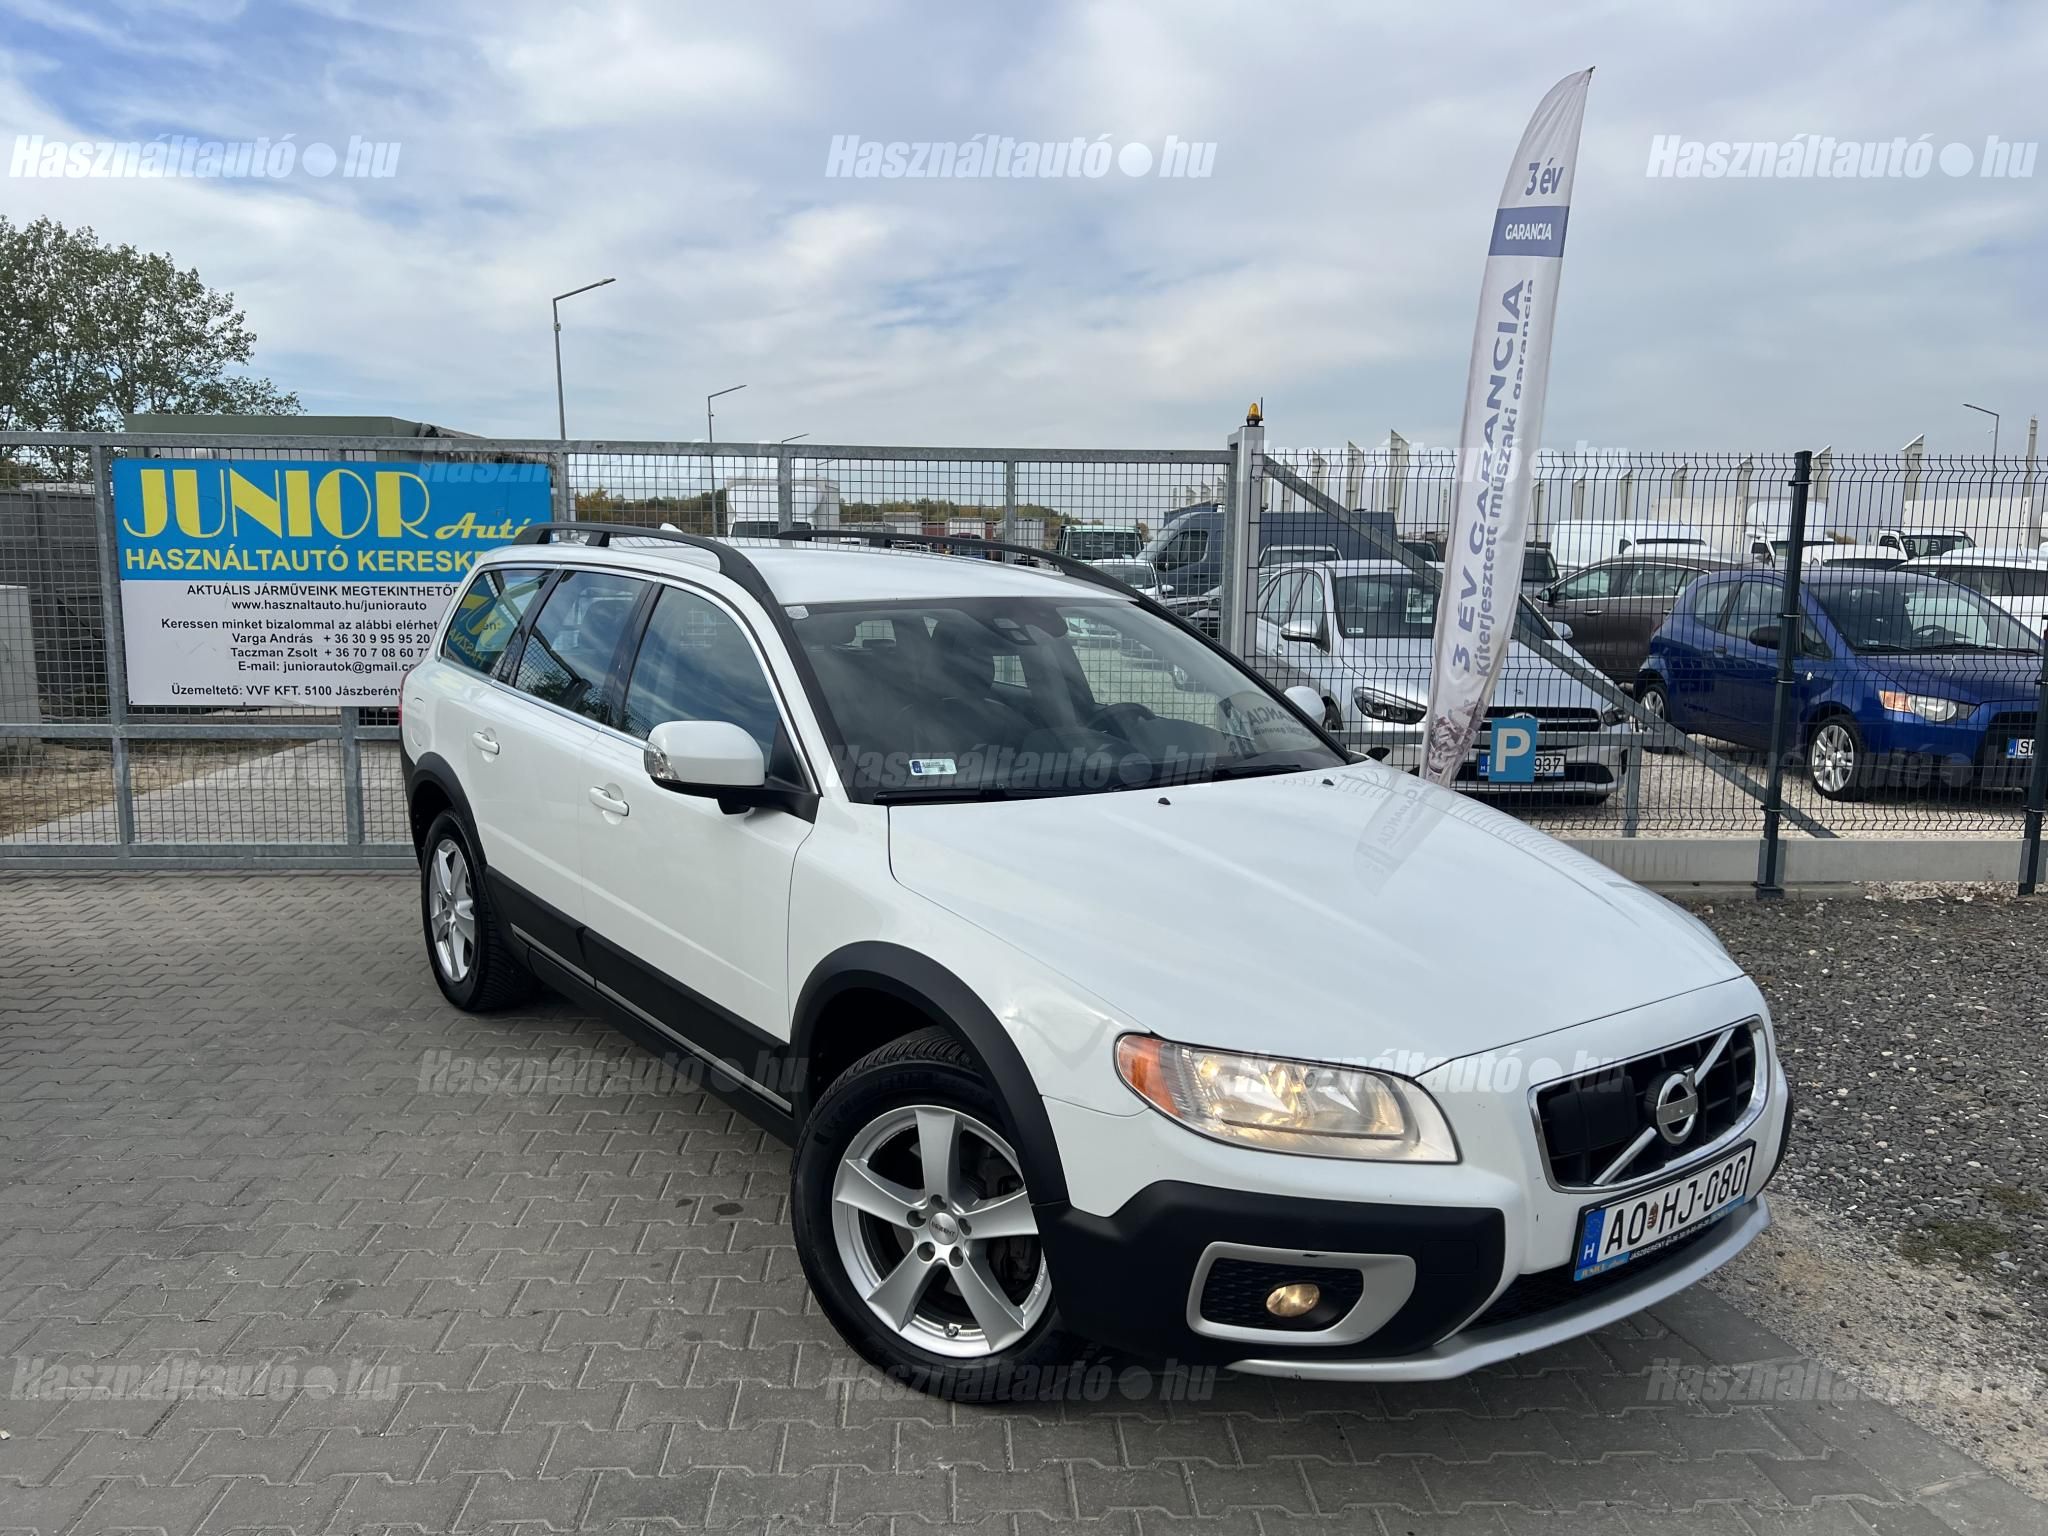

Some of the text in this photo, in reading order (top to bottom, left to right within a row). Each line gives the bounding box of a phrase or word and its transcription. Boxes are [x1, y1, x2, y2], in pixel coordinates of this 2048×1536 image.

[1525, 157, 1564, 196] 3 év
[1505, 222, 1552, 240] GARANCIA
[1453, 643, 1471, 673] 3
[1470, 280, 1524, 554] GARANCIA
[1474, 526, 1499, 677] Kiterjesztett
[1513, 280, 1534, 401] garancia
[123, 467, 430, 541] JUNIOR
[125, 543, 349, 572] HASZNÁLTAUTÓ
[187, 582, 251, 597] AKTUÁLIS
[253, 582, 338, 598] JÁRMŰVEINK
[231, 599, 427, 613] www.hasznaltauto.hu/juniorauto
[161, 618, 218, 630] Keressen
[222, 618, 262, 630] minket
[266, 618, 336, 630] bizalommal
[339, 621, 352, 630] az
[355, 618, 392, 631] alábbi
[232, 633, 430, 647] Varga András + 36 30 9 95 95 20
[230, 647, 284, 658] Taczman
[287, 647, 318, 658] Zsolt
[324, 649, 332, 657] +
[335, 648, 349, 658] 36
[352, 648, 367, 658] 70
[370, 648, 376, 658] 7
[381, 648, 396, 658] 08
[399, 648, 414, 658] 60
[238, 661, 280, 672] E-mail:
[171, 683, 243, 697] Üzemeltető:
[246, 685, 272, 697] VVF
[275, 685, 301, 697] KFT.
[305, 685, 332, 697] 5100
[1495, 728, 1531, 772] P
[1603, 1201, 1647, 1255] AO
[1657, 1155, 1747, 1235] HJ-080
[1583, 1242, 1596, 1260] H
